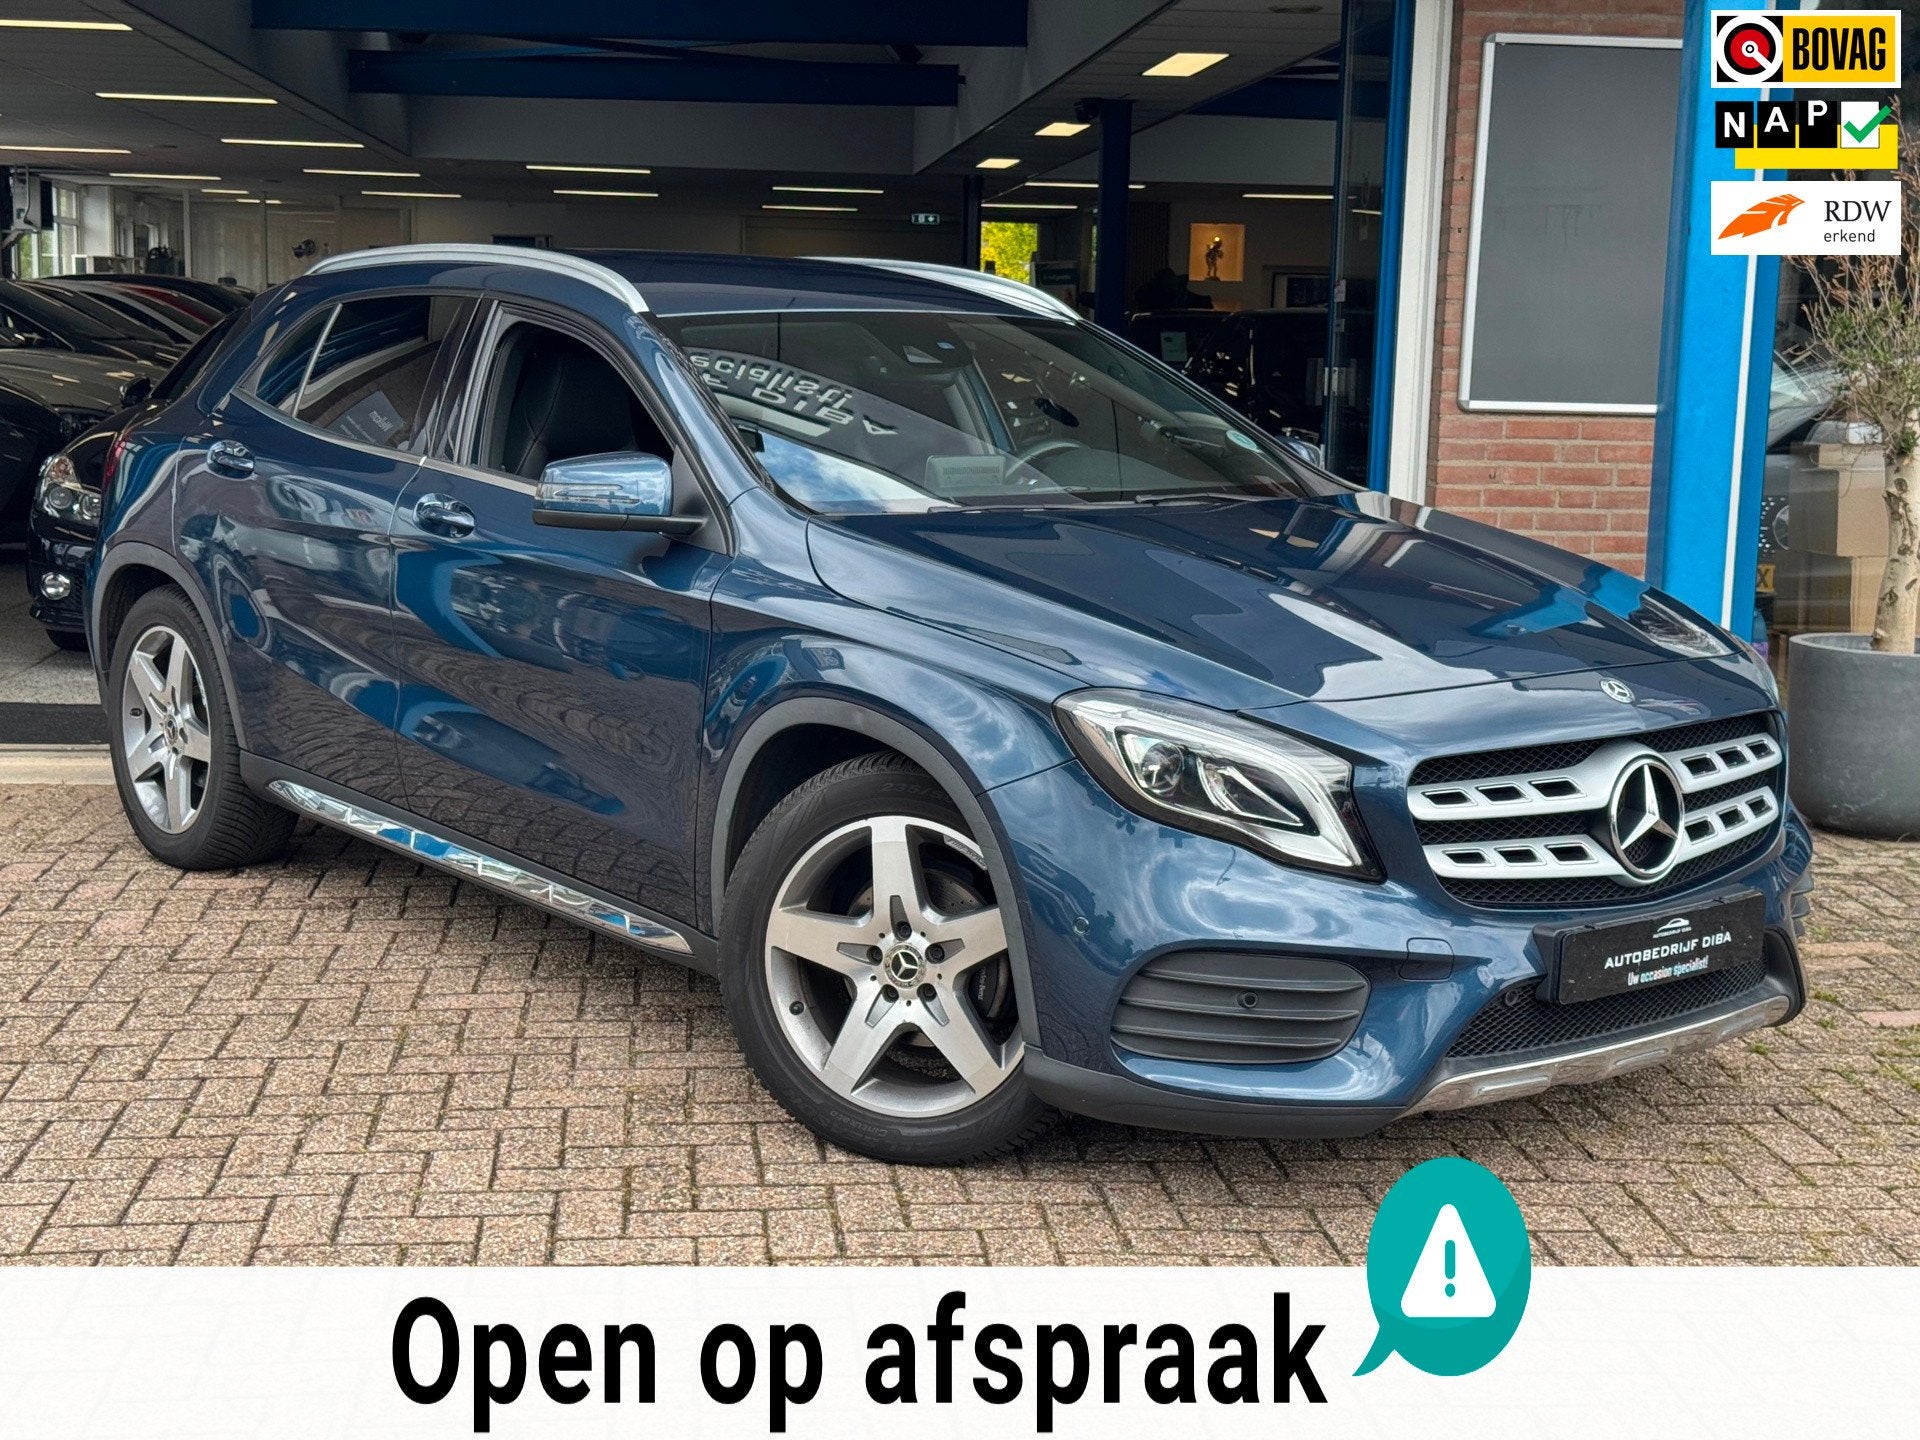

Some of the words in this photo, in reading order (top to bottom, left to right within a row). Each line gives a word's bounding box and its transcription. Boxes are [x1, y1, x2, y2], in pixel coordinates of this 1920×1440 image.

[1604, 939, 1699, 970] AUTOBEDRIJF
[1702, 931, 1732, 949] DIBA
[1627, 971, 1639, 986] Uw
[1640, 965, 1673, 984] occasion
[1673, 955, 1709, 977] specialist!
